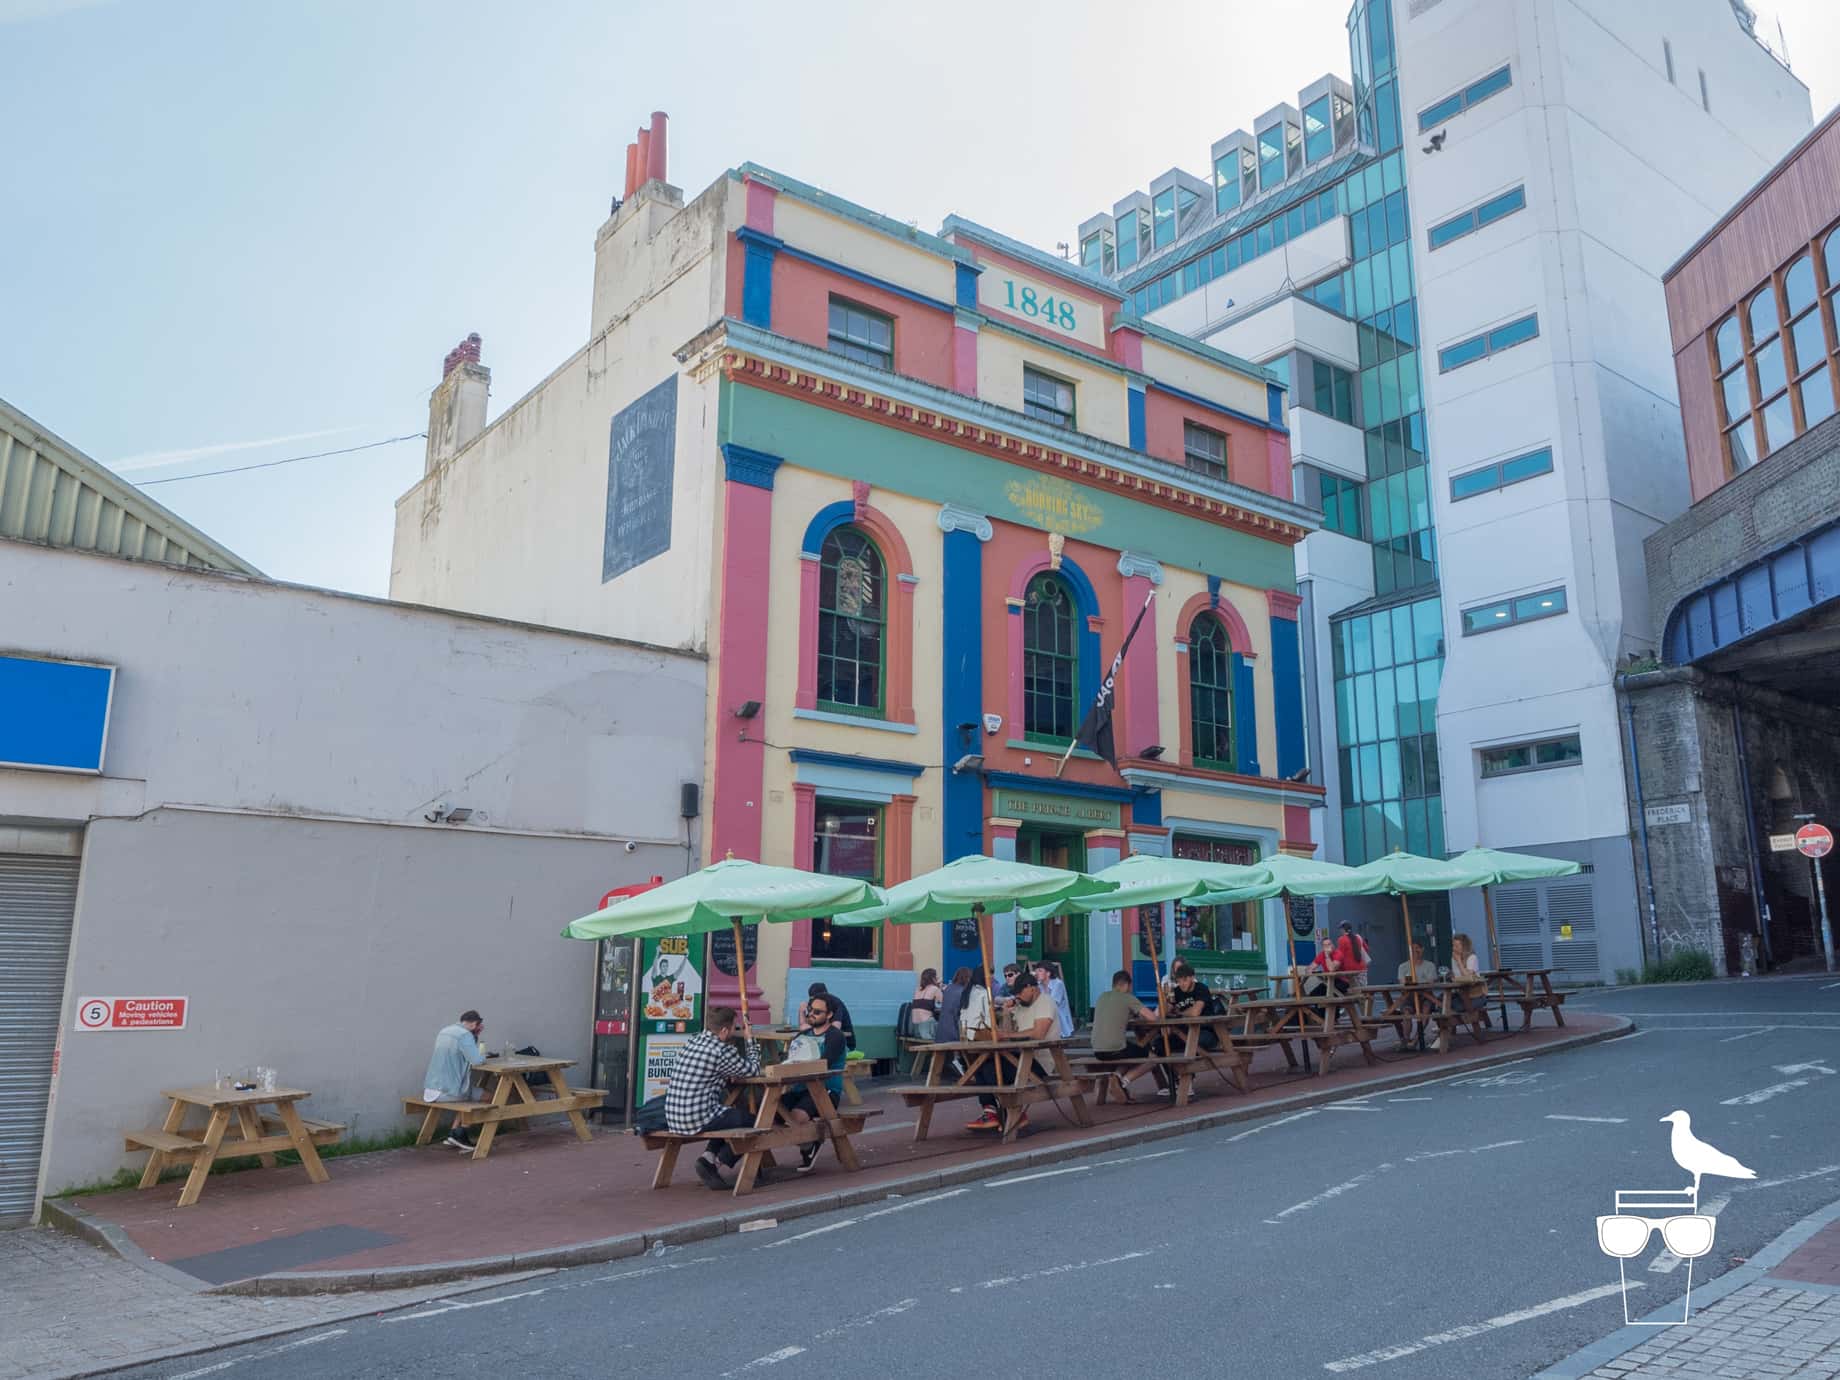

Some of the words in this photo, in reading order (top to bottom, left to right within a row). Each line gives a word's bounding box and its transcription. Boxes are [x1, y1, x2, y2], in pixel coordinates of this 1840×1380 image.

[1003, 280, 1076, 331] 1848
[1008, 799, 1026, 811] THE
[1032, 801, 1071, 817] PRINCE
[1077, 807, 1112, 821] ALBERT
[661, 938, 687, 954] SUB
[126, 1001, 173, 1011] Caution
[91, 1007, 101, 1020] 5
[130, 1018, 173, 1026] pedestrians
[648, 1058, 674, 1067] MATCH
